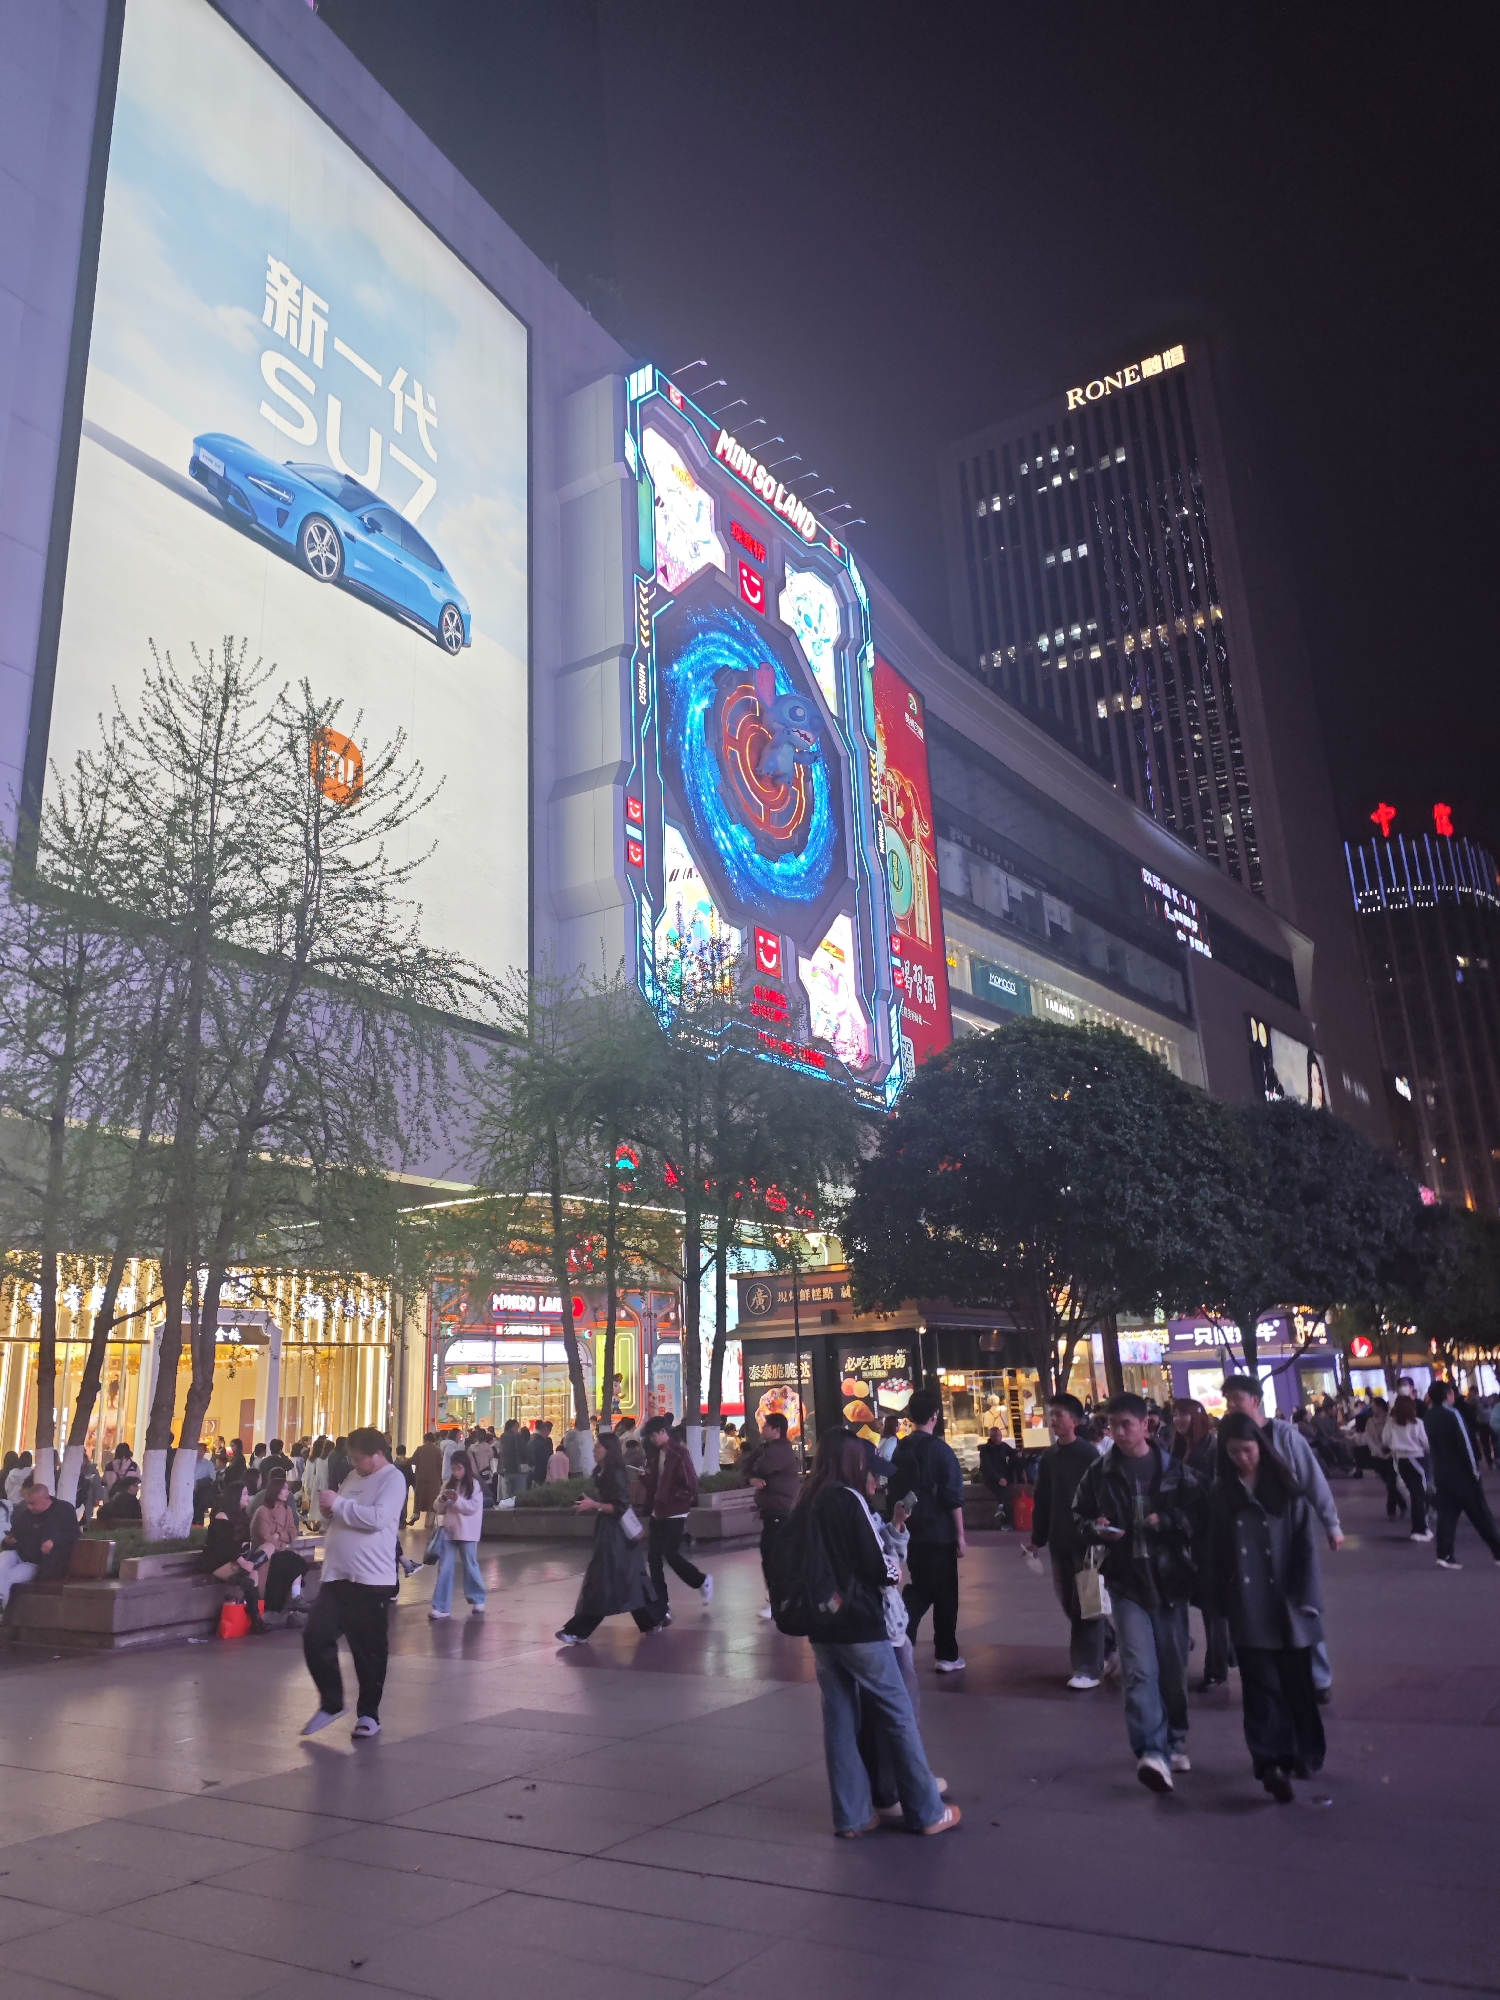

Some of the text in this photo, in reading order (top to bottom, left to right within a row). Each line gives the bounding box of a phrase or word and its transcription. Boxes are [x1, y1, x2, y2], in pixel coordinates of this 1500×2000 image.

[262, 253, 437, 463] 新一代
[1066, 364, 1140, 411] RONE
[260, 350, 437, 525] SU7
[638, 662, 646, 705] MINISO
[877, 820, 886, 854] MINISO
[493, 1294, 565, 1313] MINISO LAN
[845, 1353, 906, 1372] 必吃推荐榜
